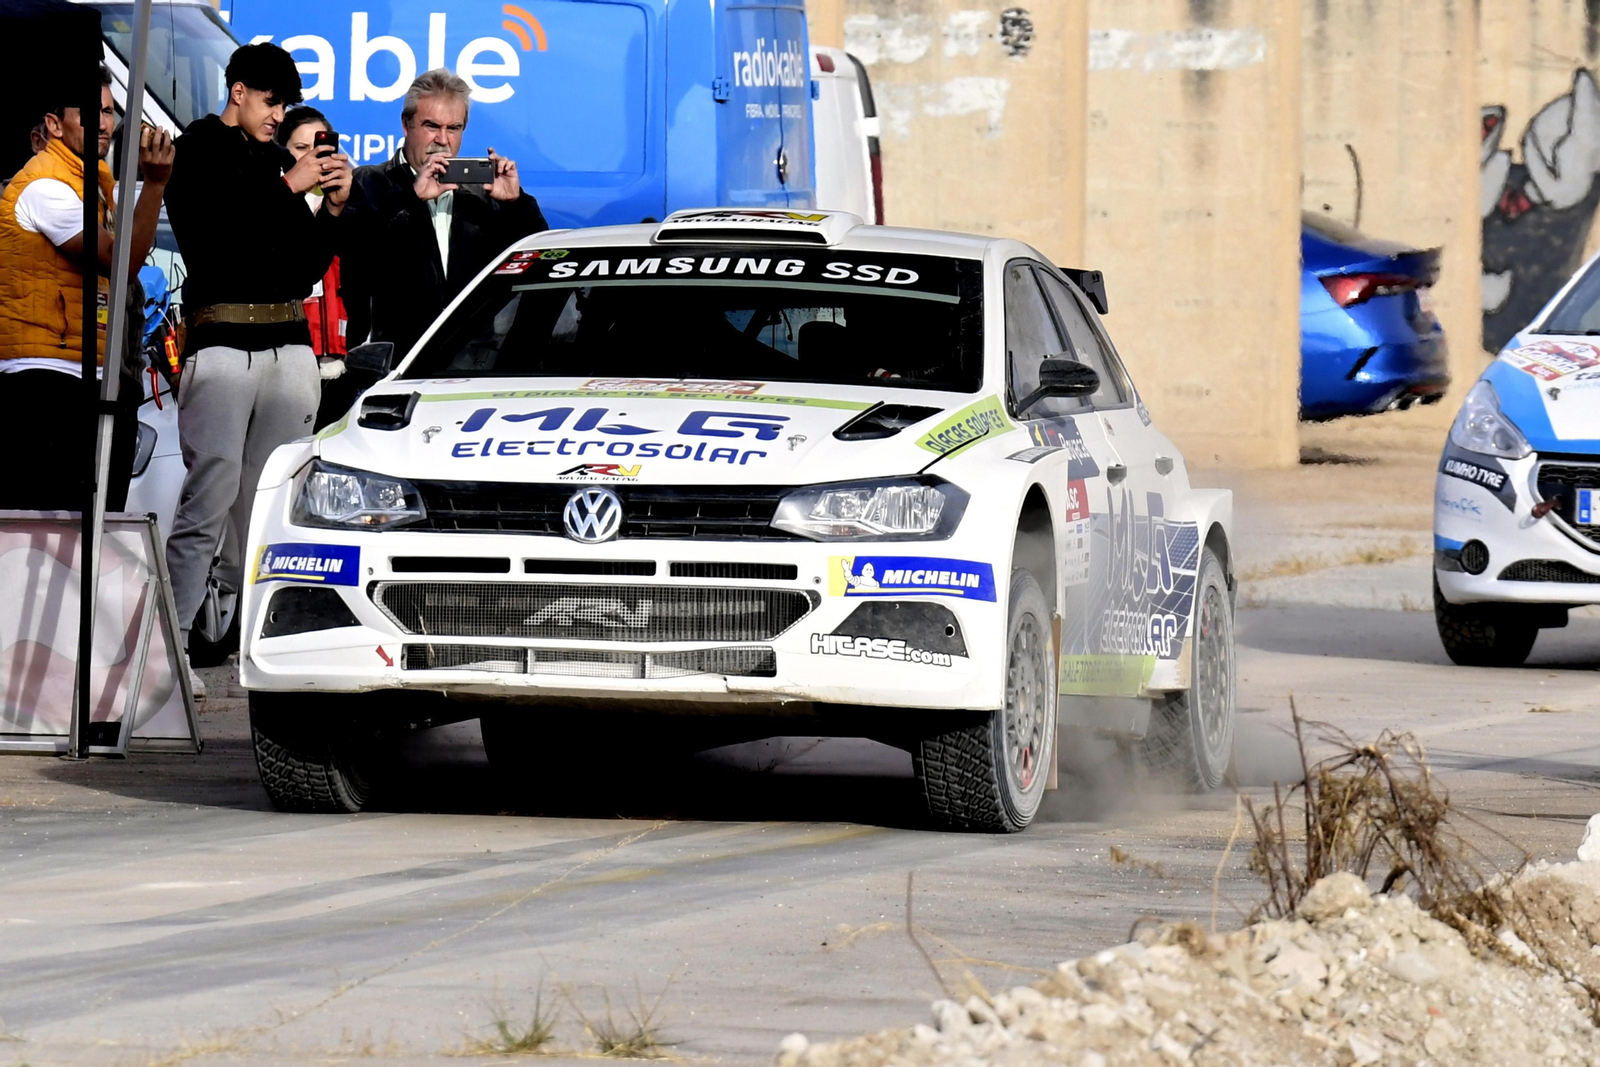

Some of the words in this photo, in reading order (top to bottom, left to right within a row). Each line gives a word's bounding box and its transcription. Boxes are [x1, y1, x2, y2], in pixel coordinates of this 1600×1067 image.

[219, 11, 520, 104] able
[733, 37, 804, 87] radiokable
[548, 257, 806, 279] SAMSUNG
[821, 262, 919, 285] SSD
[451, 437, 767, 465] electrosolar
[1445, 460, 1477, 479] KUMHO
[1476, 468, 1504, 488] TYRE
[272, 556, 343, 573] MICHELIN
[882, 569, 980, 588] MICHELIN
